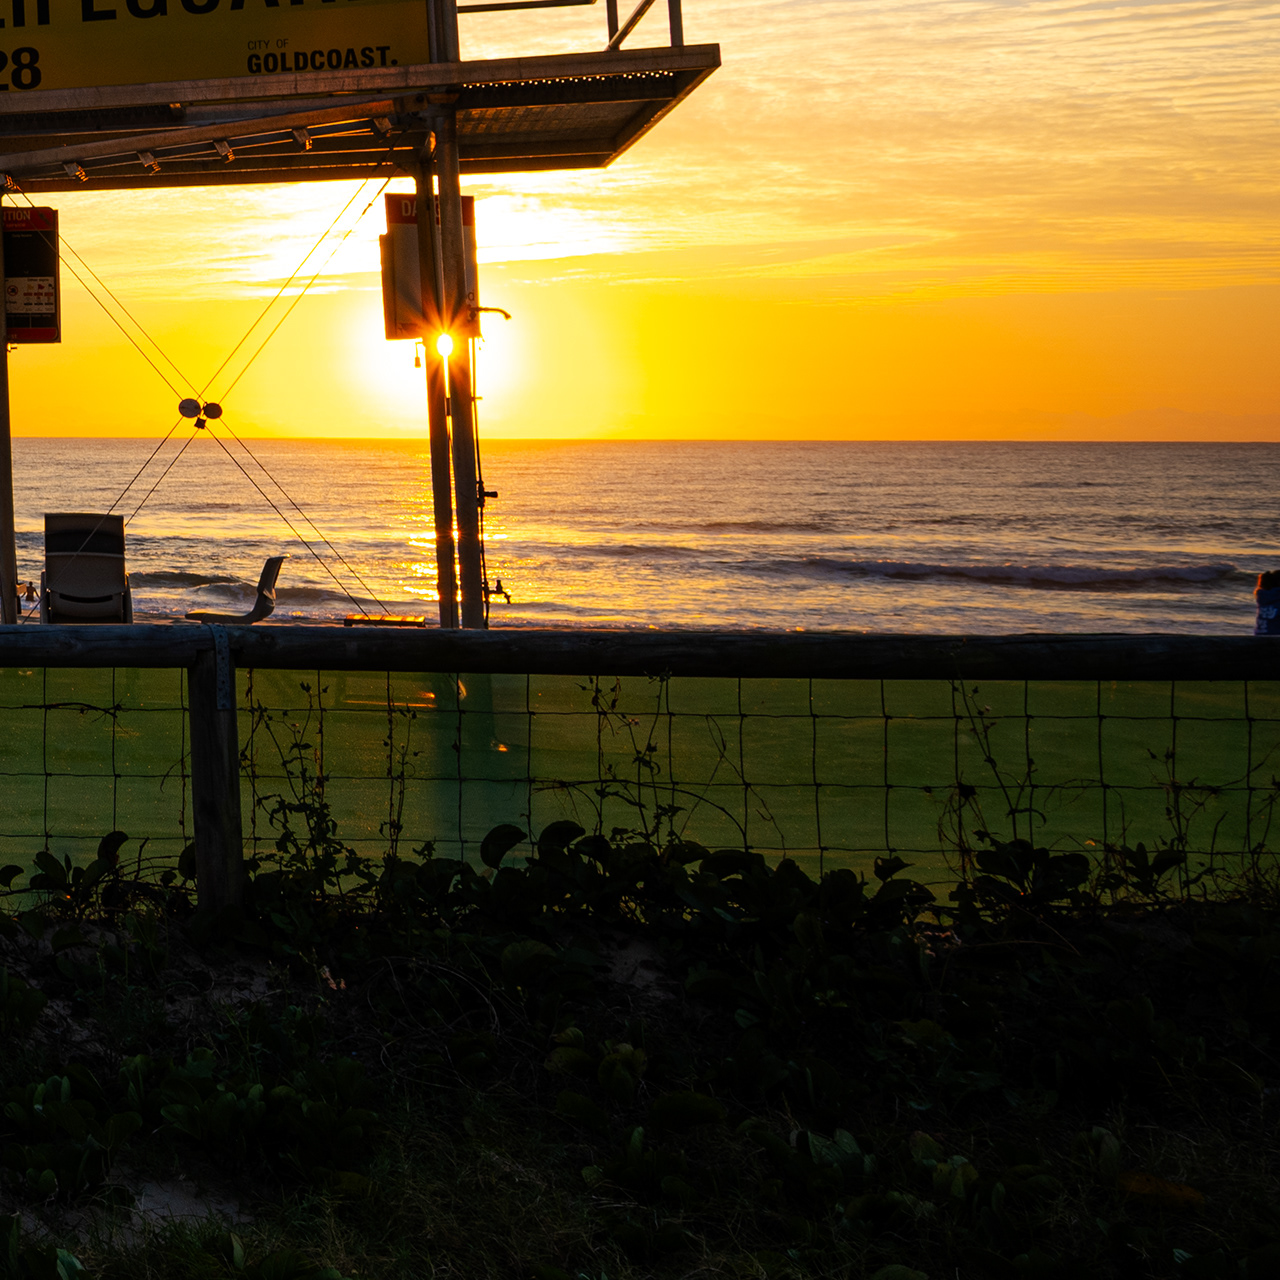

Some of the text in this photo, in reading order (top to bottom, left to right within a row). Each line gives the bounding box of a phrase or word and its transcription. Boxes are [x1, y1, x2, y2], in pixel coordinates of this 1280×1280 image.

[247, 38, 289, 50] CITY OF
[247, 46, 399, 74] GOLDCOAST.
